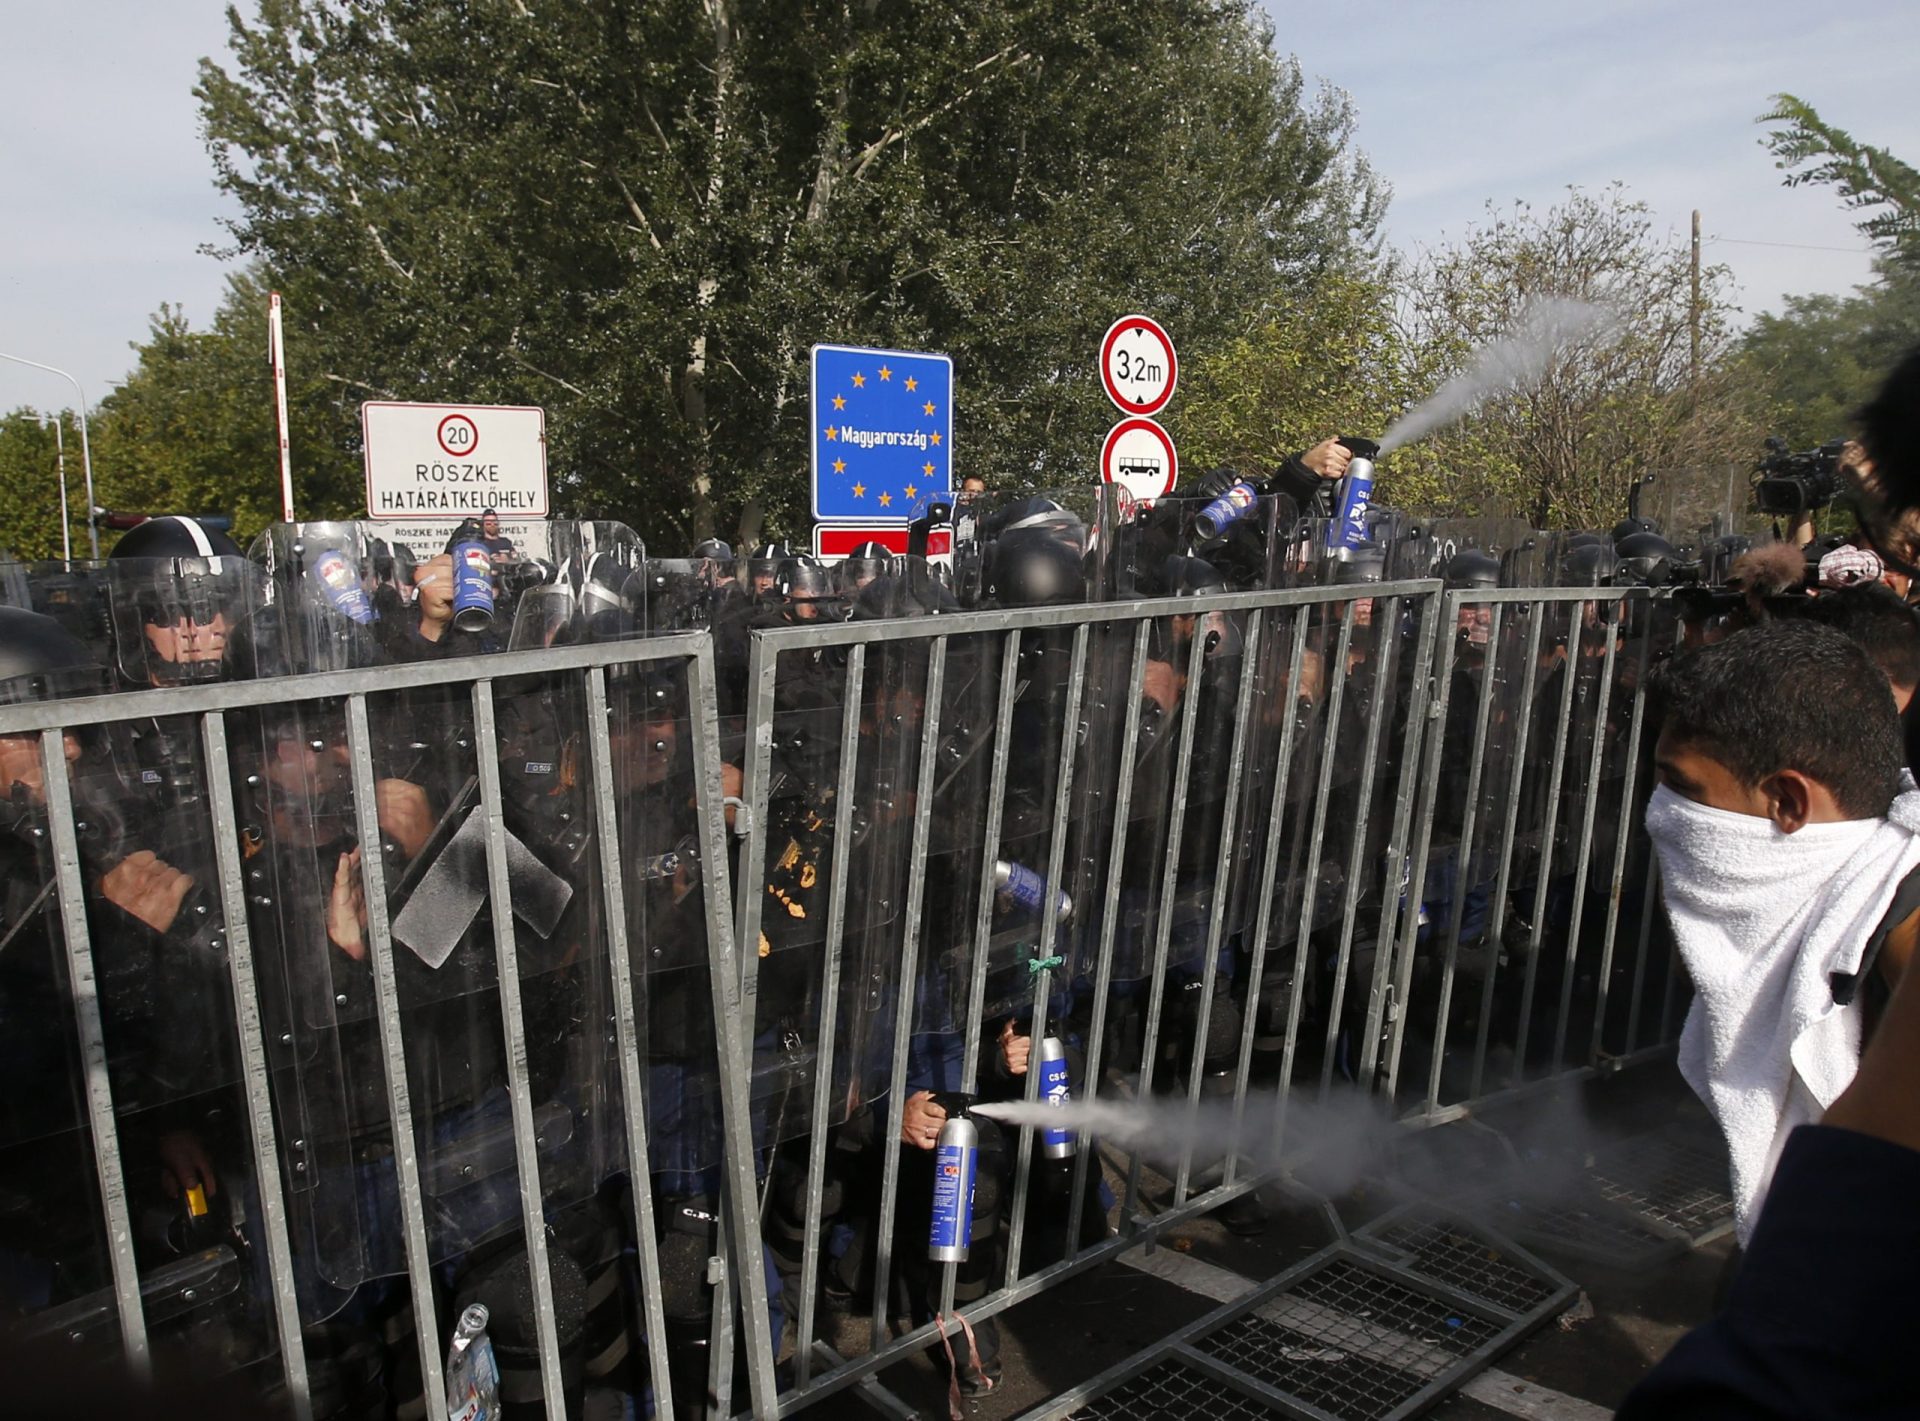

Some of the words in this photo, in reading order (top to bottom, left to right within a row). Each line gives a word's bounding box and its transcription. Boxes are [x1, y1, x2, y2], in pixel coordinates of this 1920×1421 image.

[1117, 350, 1162, 384] 3,2m
[446, 426, 469, 445] 20
[841, 425, 928, 450] Magyarország
[416, 460, 500, 483] RÖSZKE
[381, 486, 536, 510] HATÁRÁTKELŐHELY
[1049, 1073, 1060, 1082] CS
